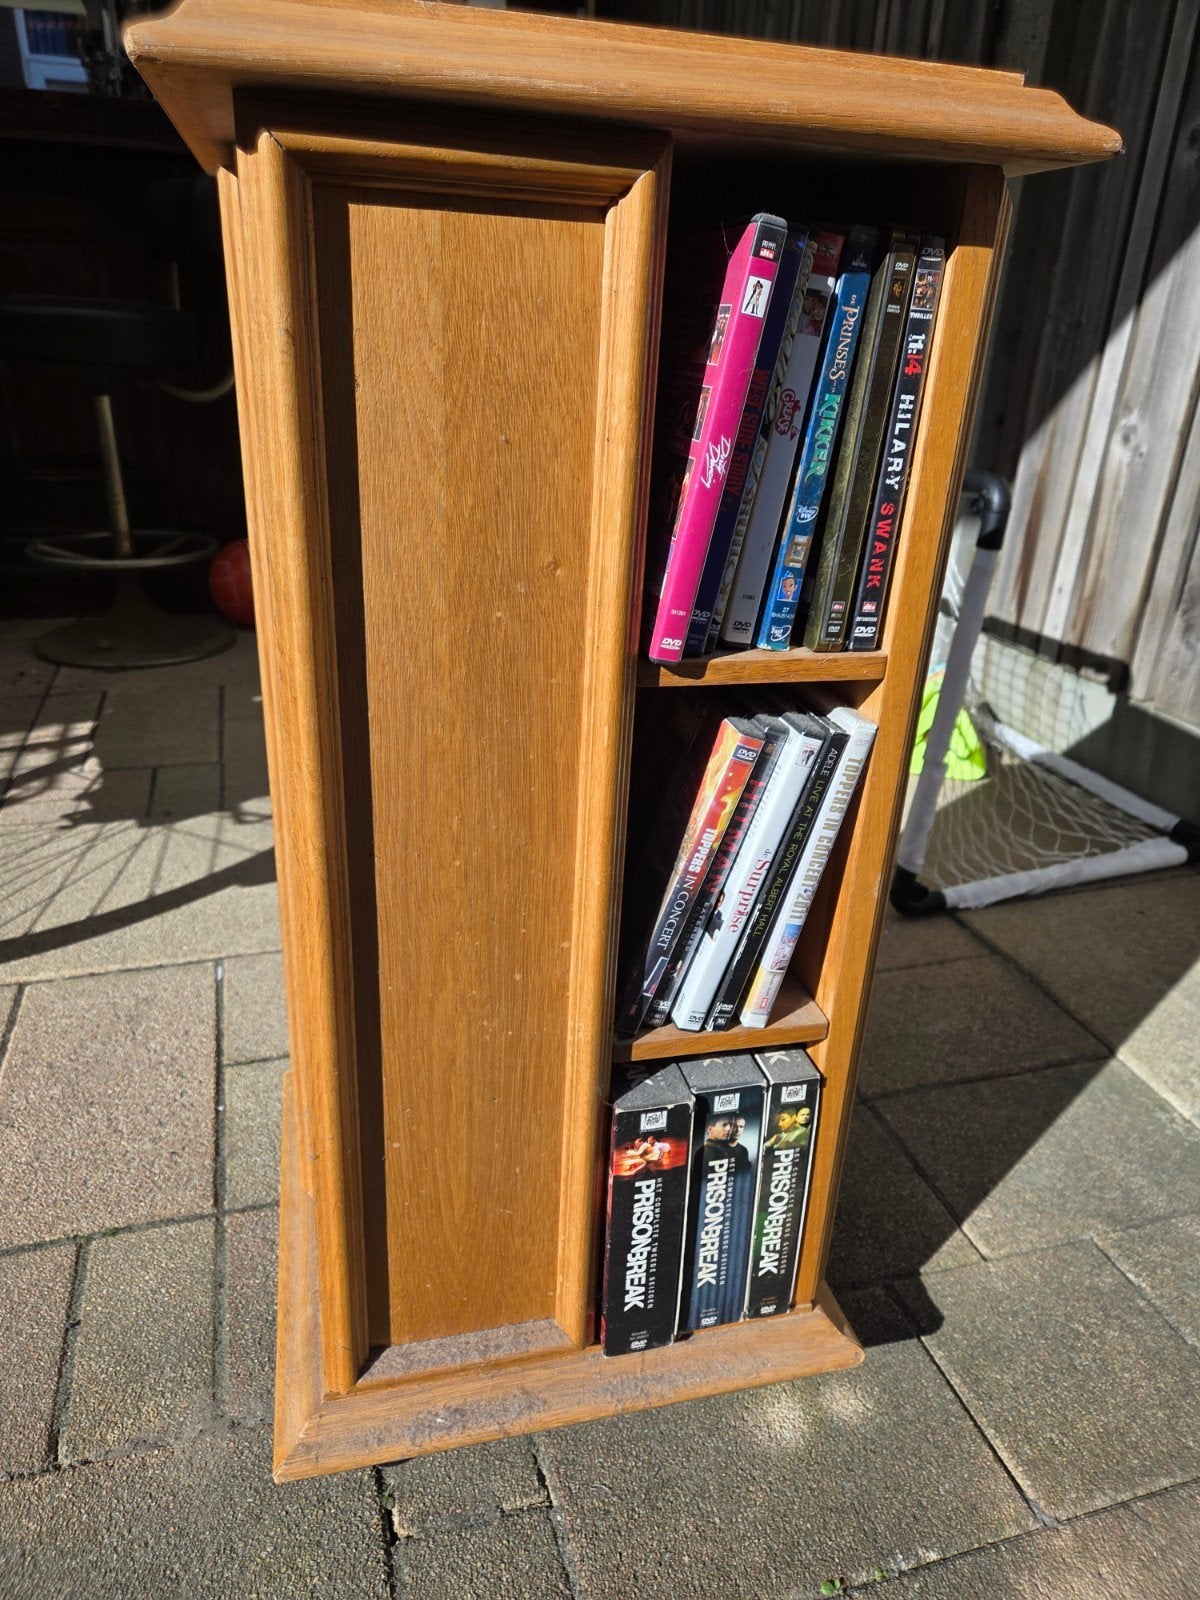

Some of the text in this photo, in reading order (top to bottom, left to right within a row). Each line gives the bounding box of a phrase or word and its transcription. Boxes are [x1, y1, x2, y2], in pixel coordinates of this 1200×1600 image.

[922, 247, 944, 257] DVD
[910, 312, 933, 320] THRILLER
[829, 305, 860, 380] PRINSES
[903, 333, 926, 377] 11:14
[805, 393, 841, 482] KIKKER
[885, 394, 915, 490] HILARY
[866, 502, 896, 588] SWANK
[661, 637, 682, 647] DVD
[854, 626, 876, 634] DVD
[738, 748, 757, 758] DVD
[705, 780, 764, 894] HITMAN
[753, 748, 838, 938] ADELE LIVE AT THE ROYAL ALBERT HALL
[764, 848, 772, 859] de
[789, 757, 863, 921] TOPPERS IN CONCERT 2011
[657, 827, 717, 950] TOPPERS IN CONCERT
[728, 859, 771, 933] Surprise
[787, 1166, 798, 1208] COMPLETE
[652, 1197, 662, 1238] COMPLETE
[719, 1157, 736, 1286] HET COMPLETE VIERDE SEIZOEN
[649, 1242, 658, 1273] TWEEDE
[780, 1241, 790, 1275] SEIZOEN
[647, 1276, 656, 1309] SEIZOEN
